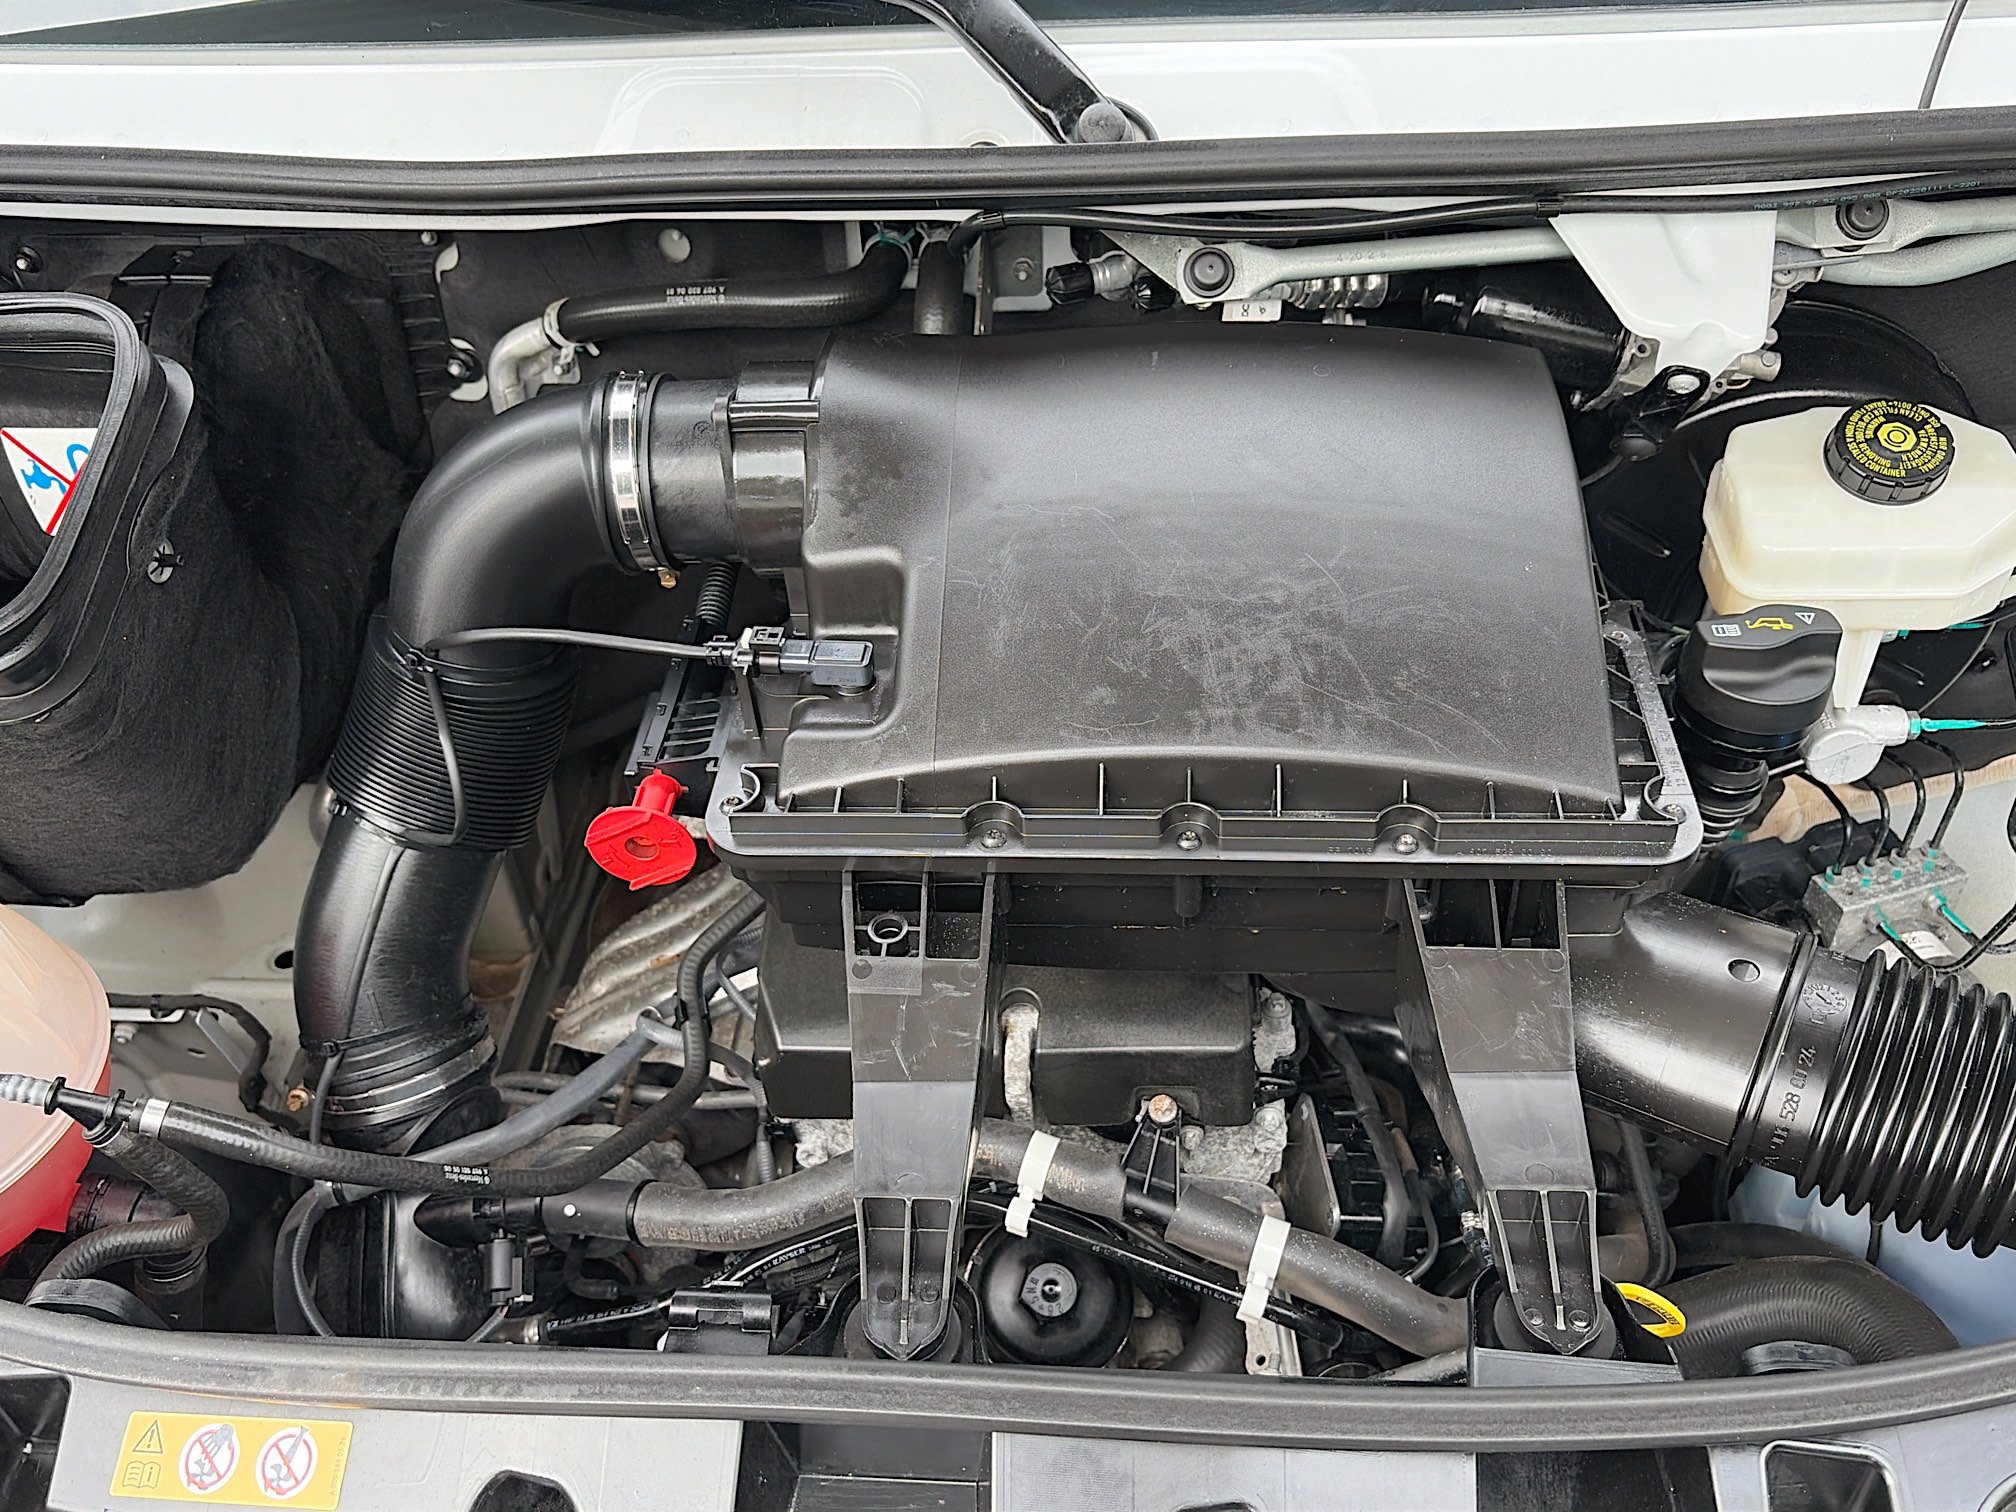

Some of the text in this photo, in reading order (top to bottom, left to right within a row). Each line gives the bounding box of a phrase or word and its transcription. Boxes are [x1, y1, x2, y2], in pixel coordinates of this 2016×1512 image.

[1849, 407, 1867, 422] FLUID
[1863, 400, 1888, 411] BRAKE
[1912, 405, 1931, 418] ONLY
[1845, 421, 1856, 438] FROM
[1865, 415, 1887, 439] WARNING
[1928, 416, 1941, 429] USE
[1854, 406, 1923, 468] CLEAN FILLER CAP BEFORE REMOVING
[1901, 429, 1929, 462] VERWENDEN
[1847, 442, 1866, 464] SEALED
[1918, 436, 1948, 474] NUR ORIGINAL
[1864, 460, 1907, 478] CONTAINER
[1779, 1091, 1801, 1122] 528
[1798, 1045, 1817, 1068] 24
